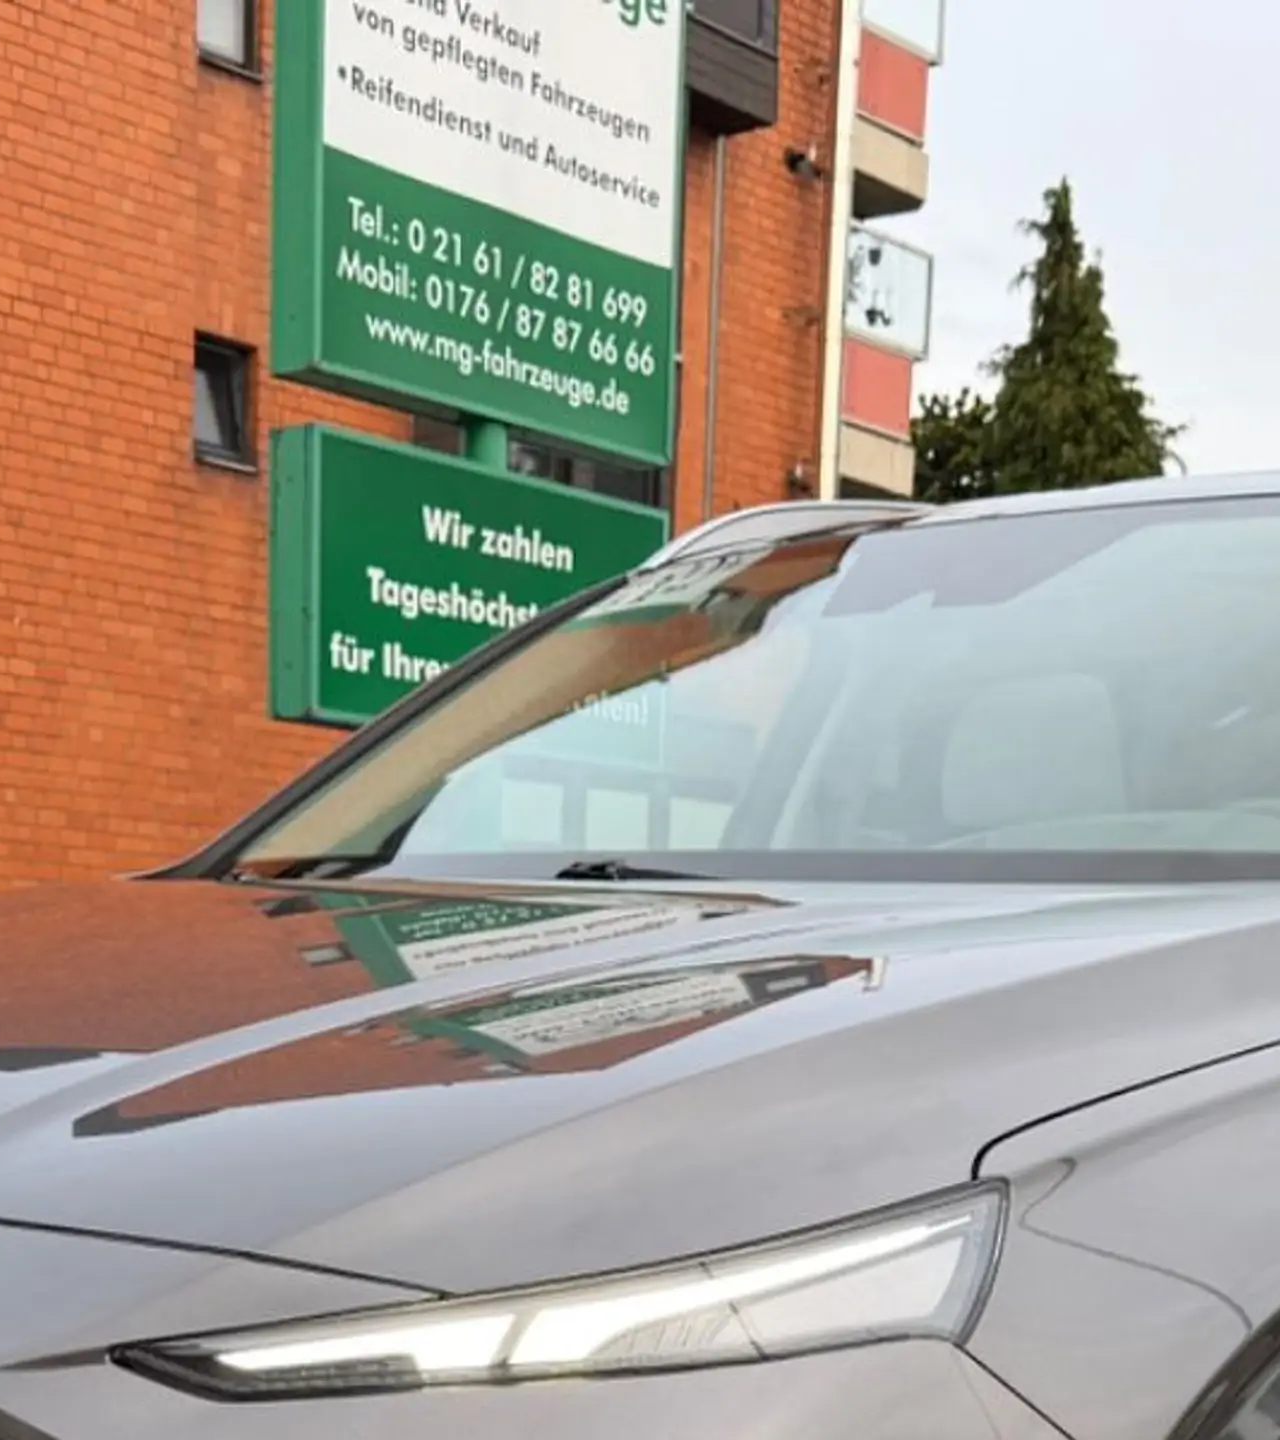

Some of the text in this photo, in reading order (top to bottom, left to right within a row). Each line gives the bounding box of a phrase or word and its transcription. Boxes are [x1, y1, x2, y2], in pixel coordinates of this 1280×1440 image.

[353, 2, 650, 143] von gepflegten Fahrzeugen
[454, 0, 540, 56] Verkauf
[498, 130, 539, 163] und
[544, 144, 660, 208] Autoservice
[347, 196, 647, 328] Tel.: 0 21 61 / 82 81 699
[336, 245, 655, 377] Mobil: 0176 / 87 87 66 66
[365, 313, 630, 414] www.mg-fahrzeuge.de
[422, 504, 574, 573] Wir zahlen
[330, 631, 452, 682] für Ihre
